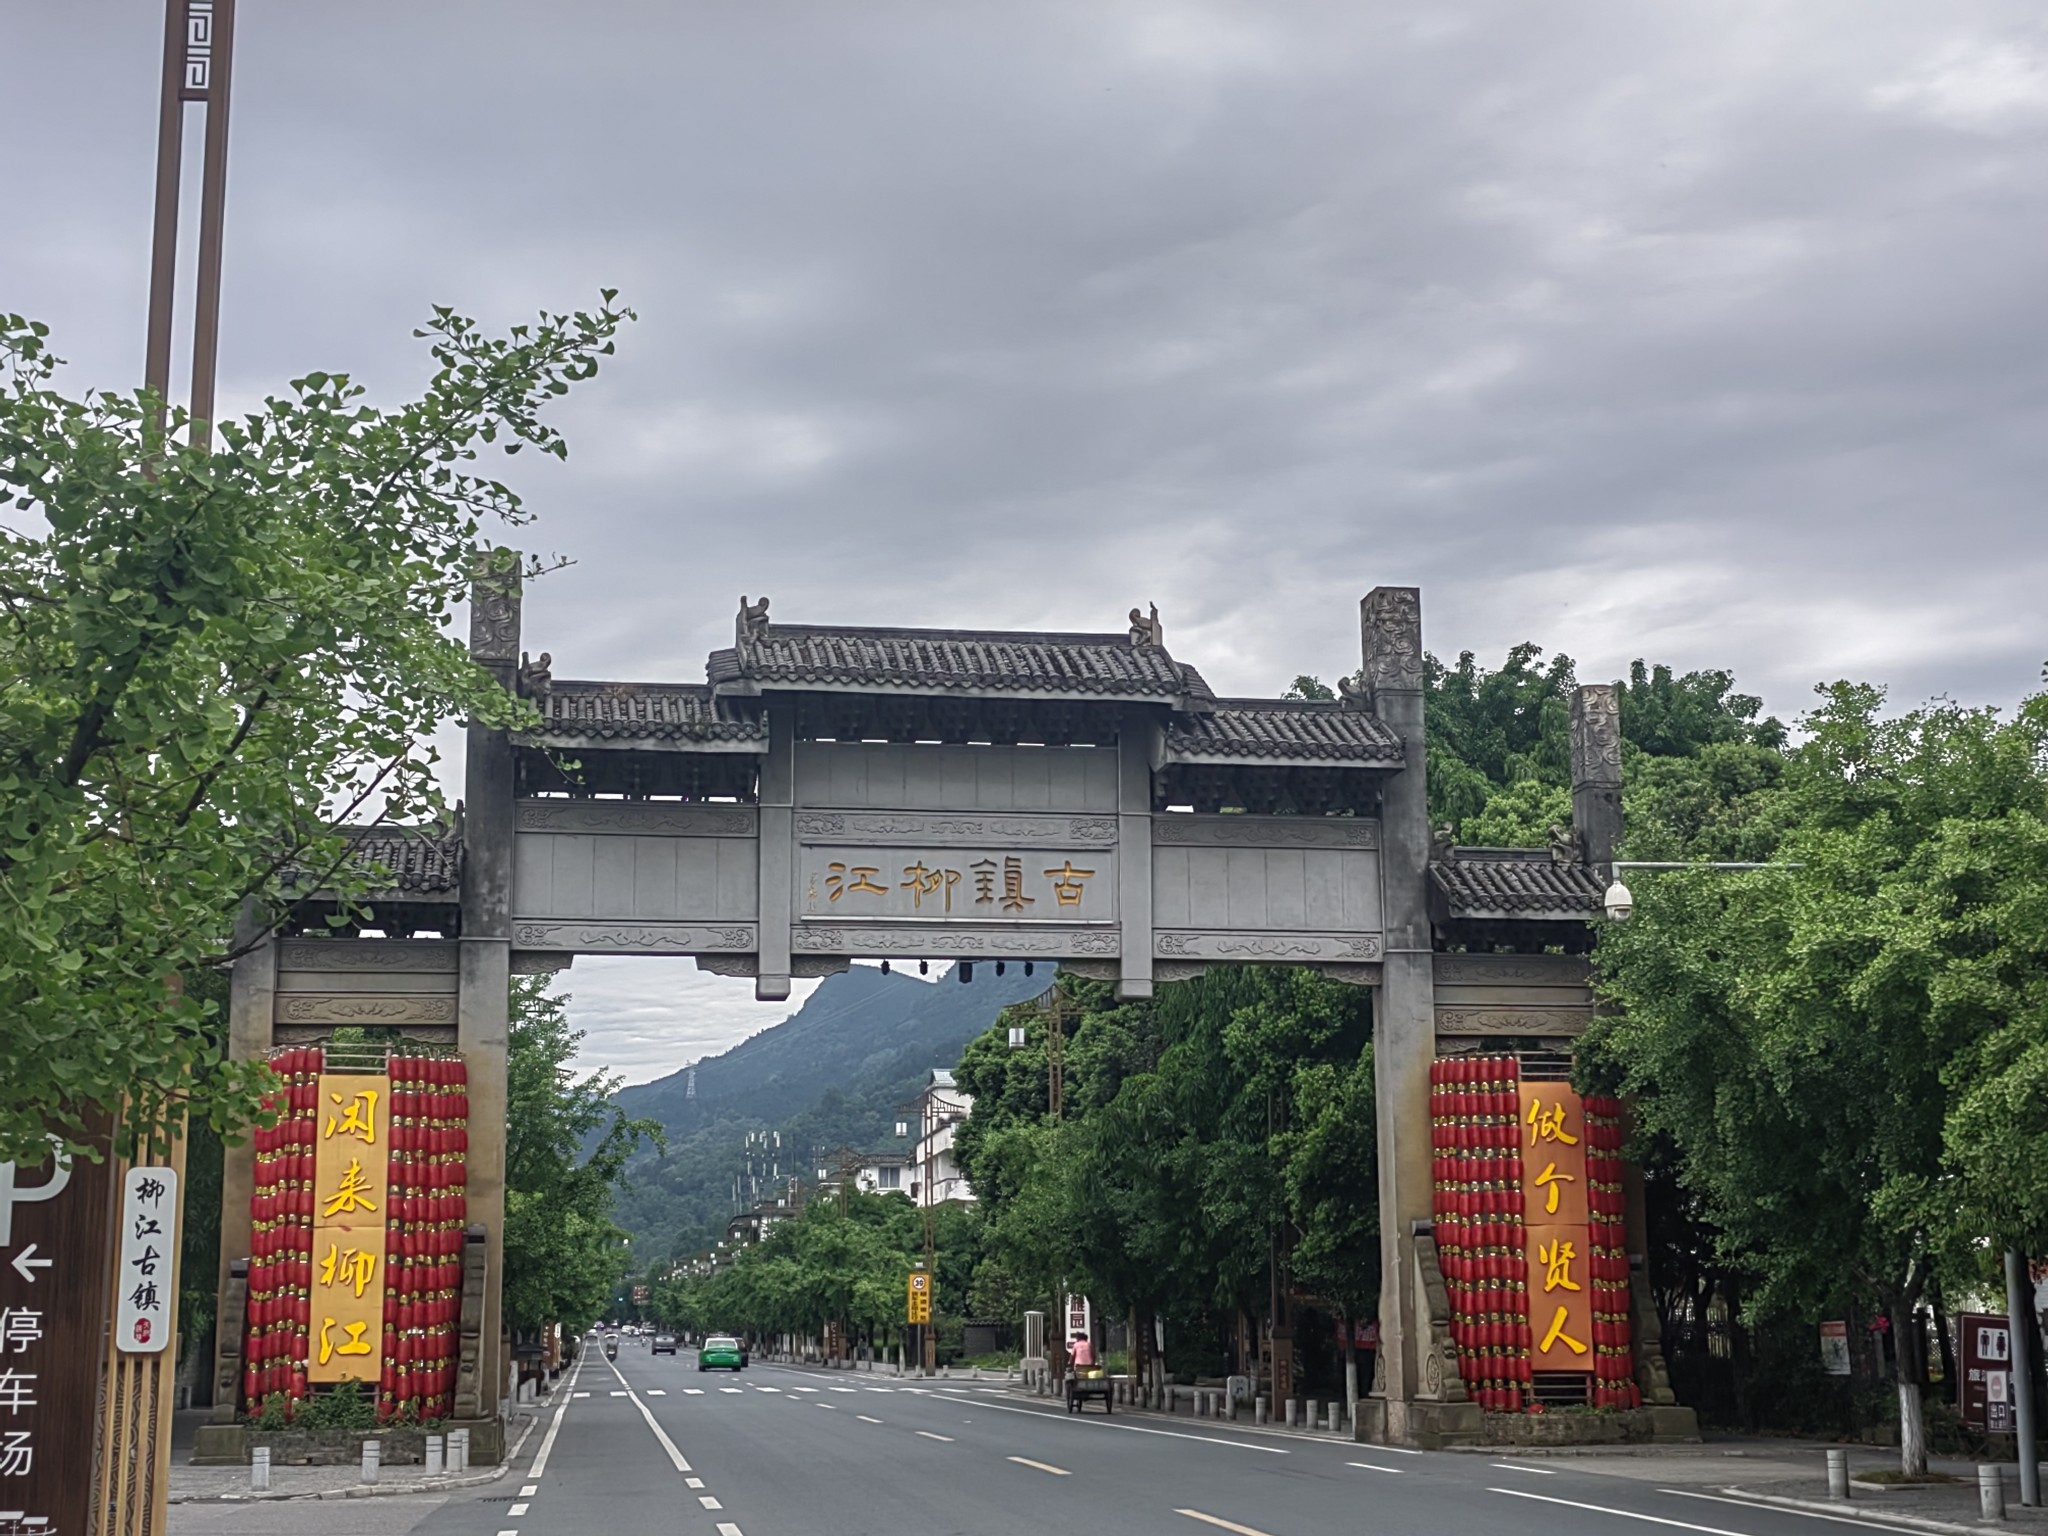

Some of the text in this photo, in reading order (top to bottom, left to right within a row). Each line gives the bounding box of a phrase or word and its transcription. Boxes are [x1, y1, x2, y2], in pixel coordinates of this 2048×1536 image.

[318, 1090, 378, 1365] 闲来柳江
[1527, 1098, 1588, 1355] 做个贤人
[0, 1306, 43, 1477] 停车场
